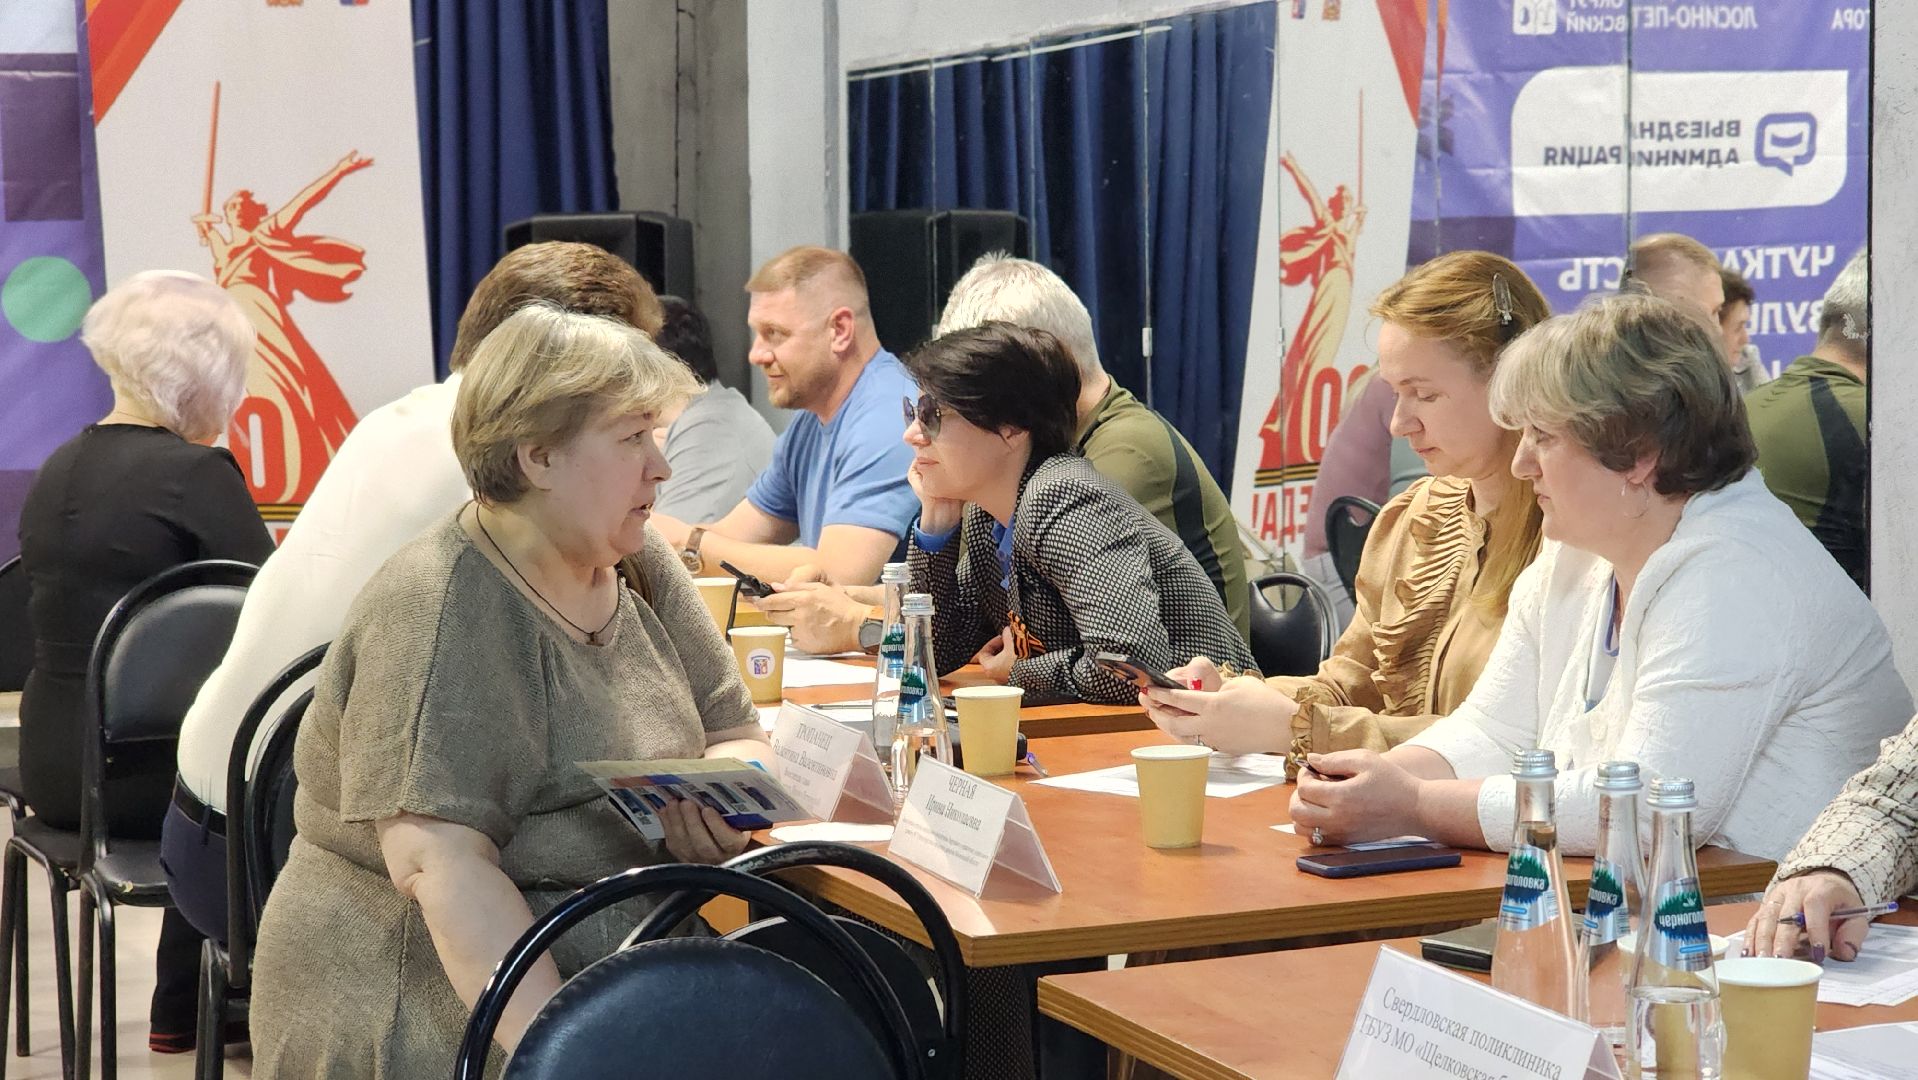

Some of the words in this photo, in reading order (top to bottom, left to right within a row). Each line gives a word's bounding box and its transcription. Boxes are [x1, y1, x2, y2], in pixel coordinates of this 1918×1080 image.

[1358, 1013, 1392, 1047] ГБУЗ
[1389, 1026, 1416, 1054] МО
[1382, 986, 1469, 1043] Свердловская
[1468, 1029, 1563, 1080] поликлиника
